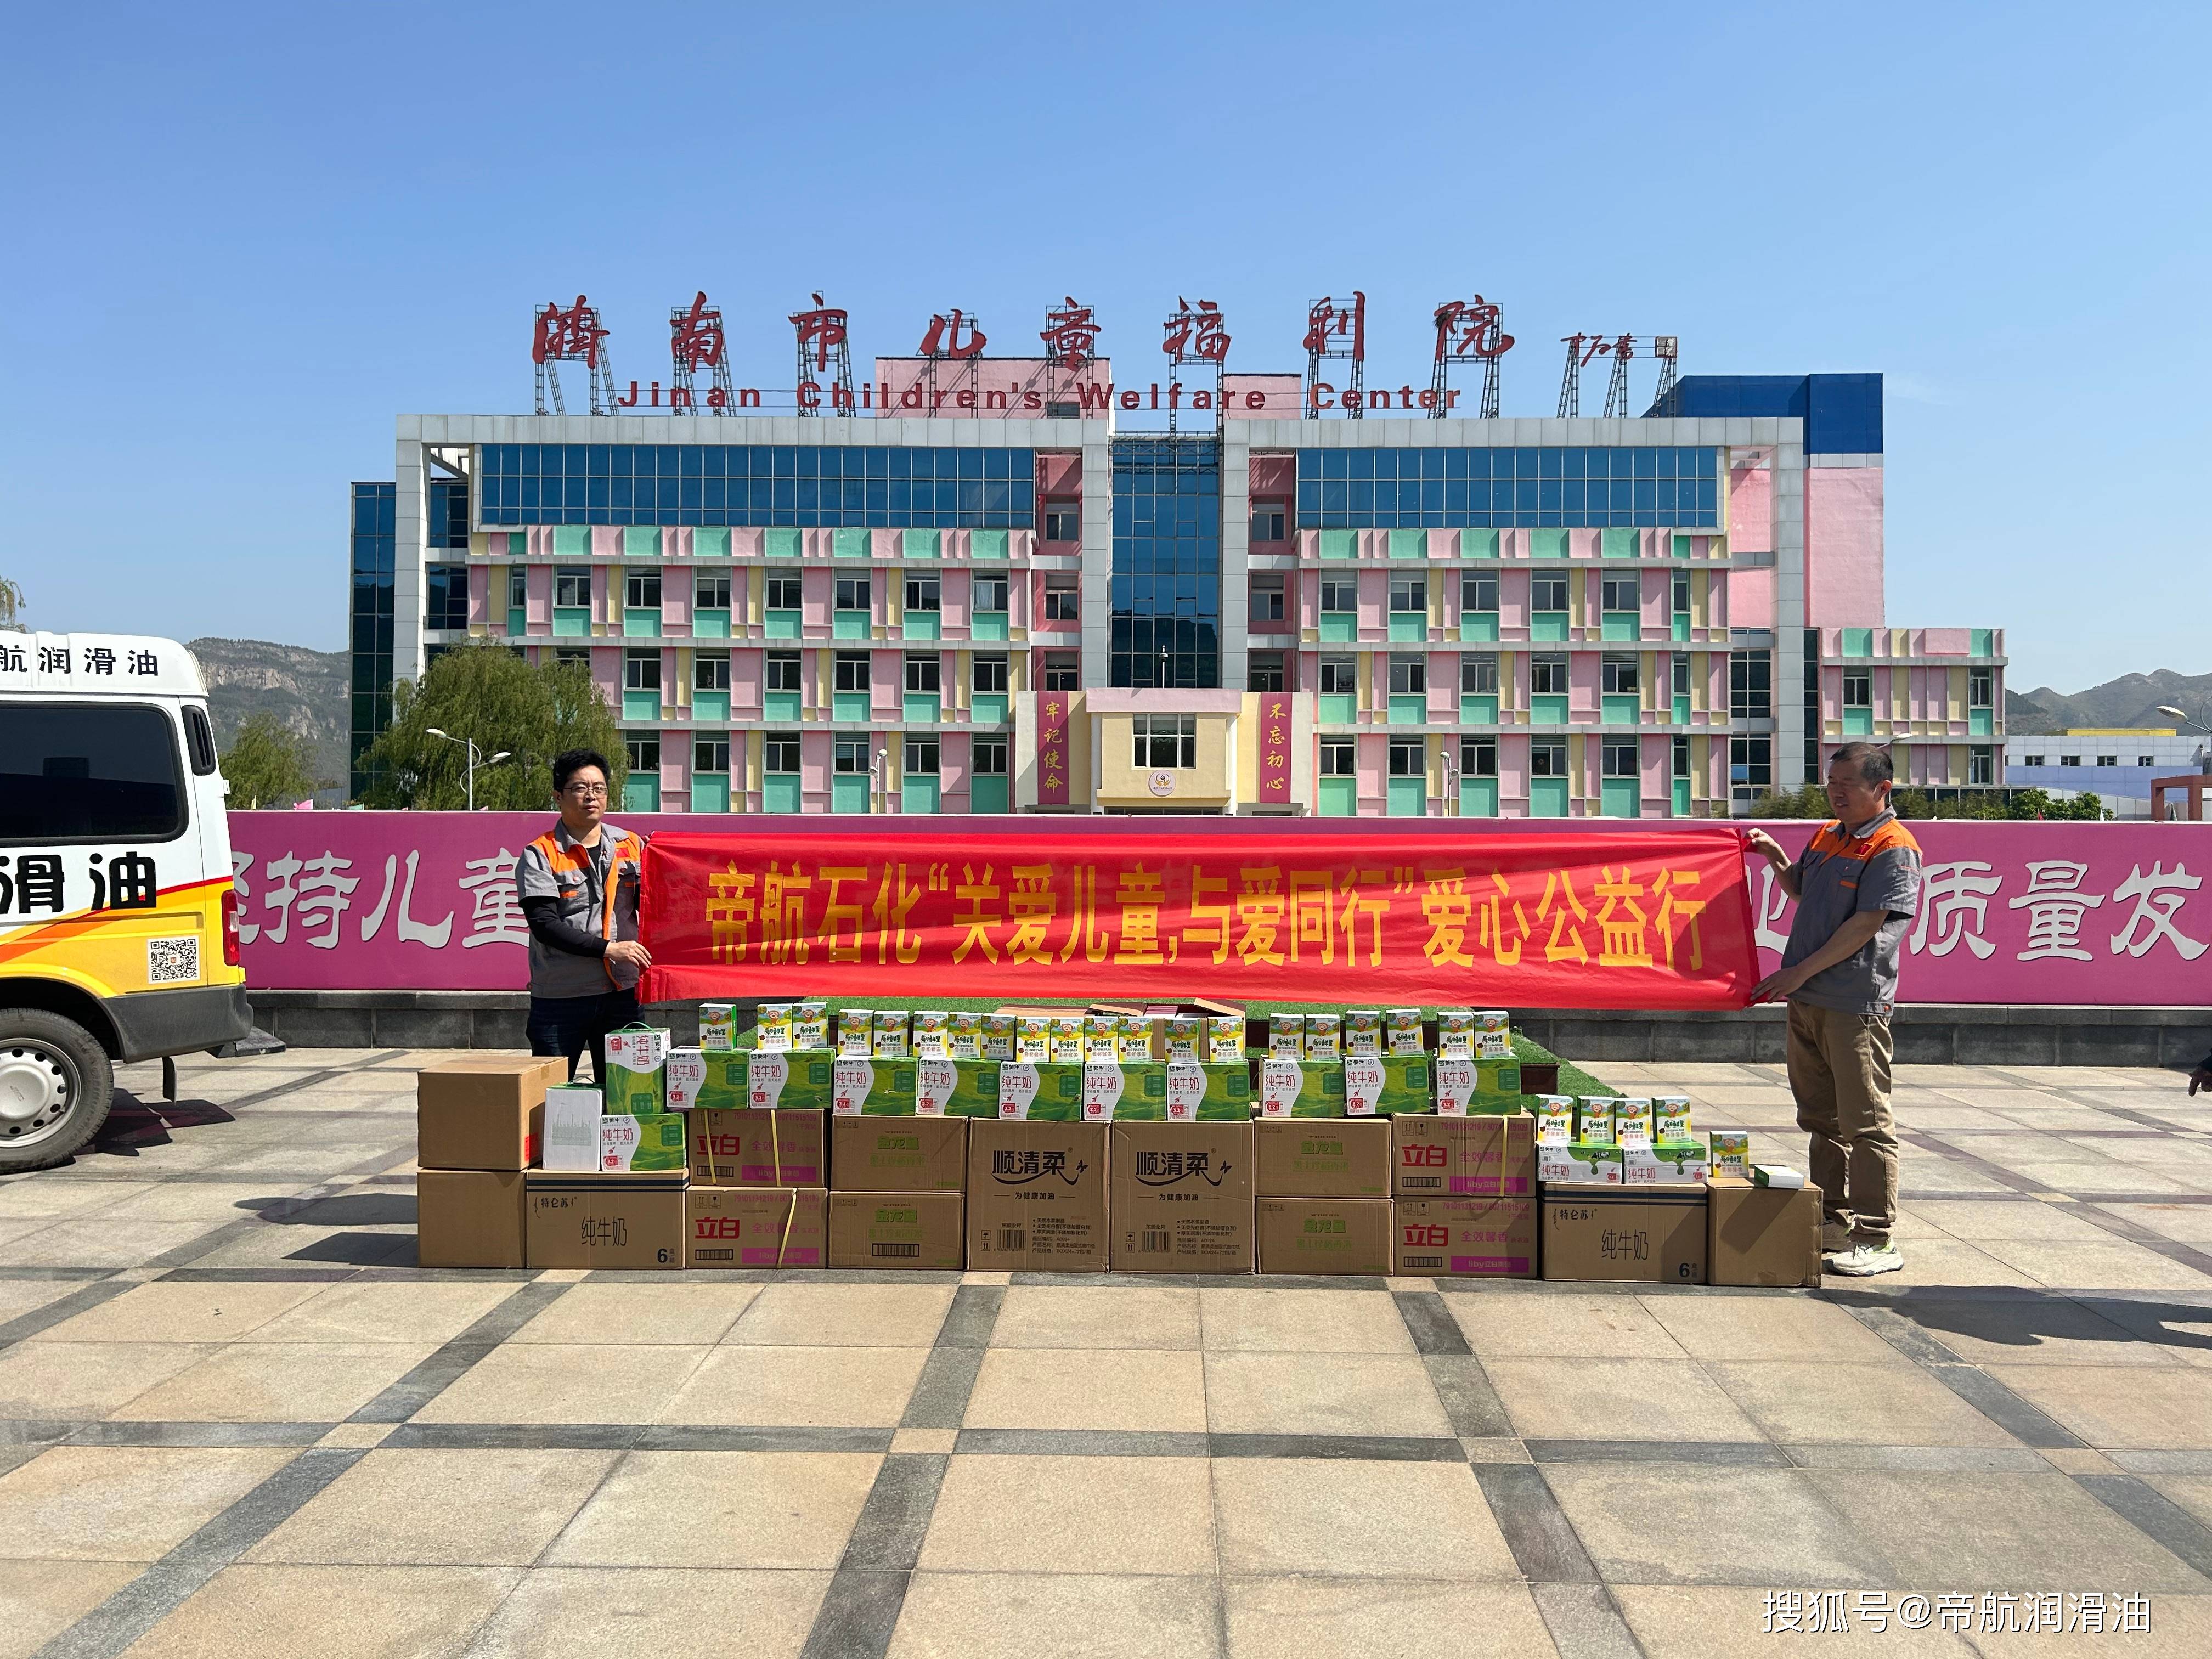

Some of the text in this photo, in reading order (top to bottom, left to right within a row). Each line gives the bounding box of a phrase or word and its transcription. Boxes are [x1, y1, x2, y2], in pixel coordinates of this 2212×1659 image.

[618, 381, 1461, 409] Jinan Children's Welfare Center
[0, 645, 159, 676] 航润滑油
[1044, 701, 1063, 794] 牢记使命
[1266, 703, 1285, 789] 不忘初心
[1910, 860, 2210, 962] 质量发
[636, 1035, 650, 1065] 纯牛奶
[669, 1064, 699, 1077] 纯牛奶
[752, 1065, 781, 1077] 纯牛奶
[836, 1071, 866, 1084] 纯牛奶
[920, 1071, 950, 1085] 纯牛奶
[1348, 1071, 1378, 1084] 纯牛奶
[1439, 1071, 1469, 1084] 纯牛奶
[1002, 1075, 1031, 1088] 纯牛奶
[1087, 1077, 1116, 1089] 纯牛奶
[1170, 1077, 1199, 1090] 纯牛奶
[1266, 1074, 1295, 1087] 纯牛奶
[603, 1128, 633, 1141] 纯牛奶
[697, 1133, 740, 1155] 立白
[992, 1150, 1065, 1175] 顺清柔
[1402, 1144, 1447, 1167] 立白
[1136, 1152, 1208, 1176] 顺清柔
[1542, 1164, 1569, 1176] 纯牛奶
[1628, 1168, 1656, 1179] 纯牛奶
[541, 1198, 568, 1208] 特仑苏
[1560, 1209, 1589, 1220] 特仑苏
[582, 1216, 627, 1246] 纯牛奶
[695, 1217, 740, 1239] 立白
[1403, 1224, 1448, 1246] 立白
[1601, 1229, 1649, 1260] 纯牛奶
[657, 1248, 668, 1263] 6
[1679, 1262, 1690, 1277] 6
